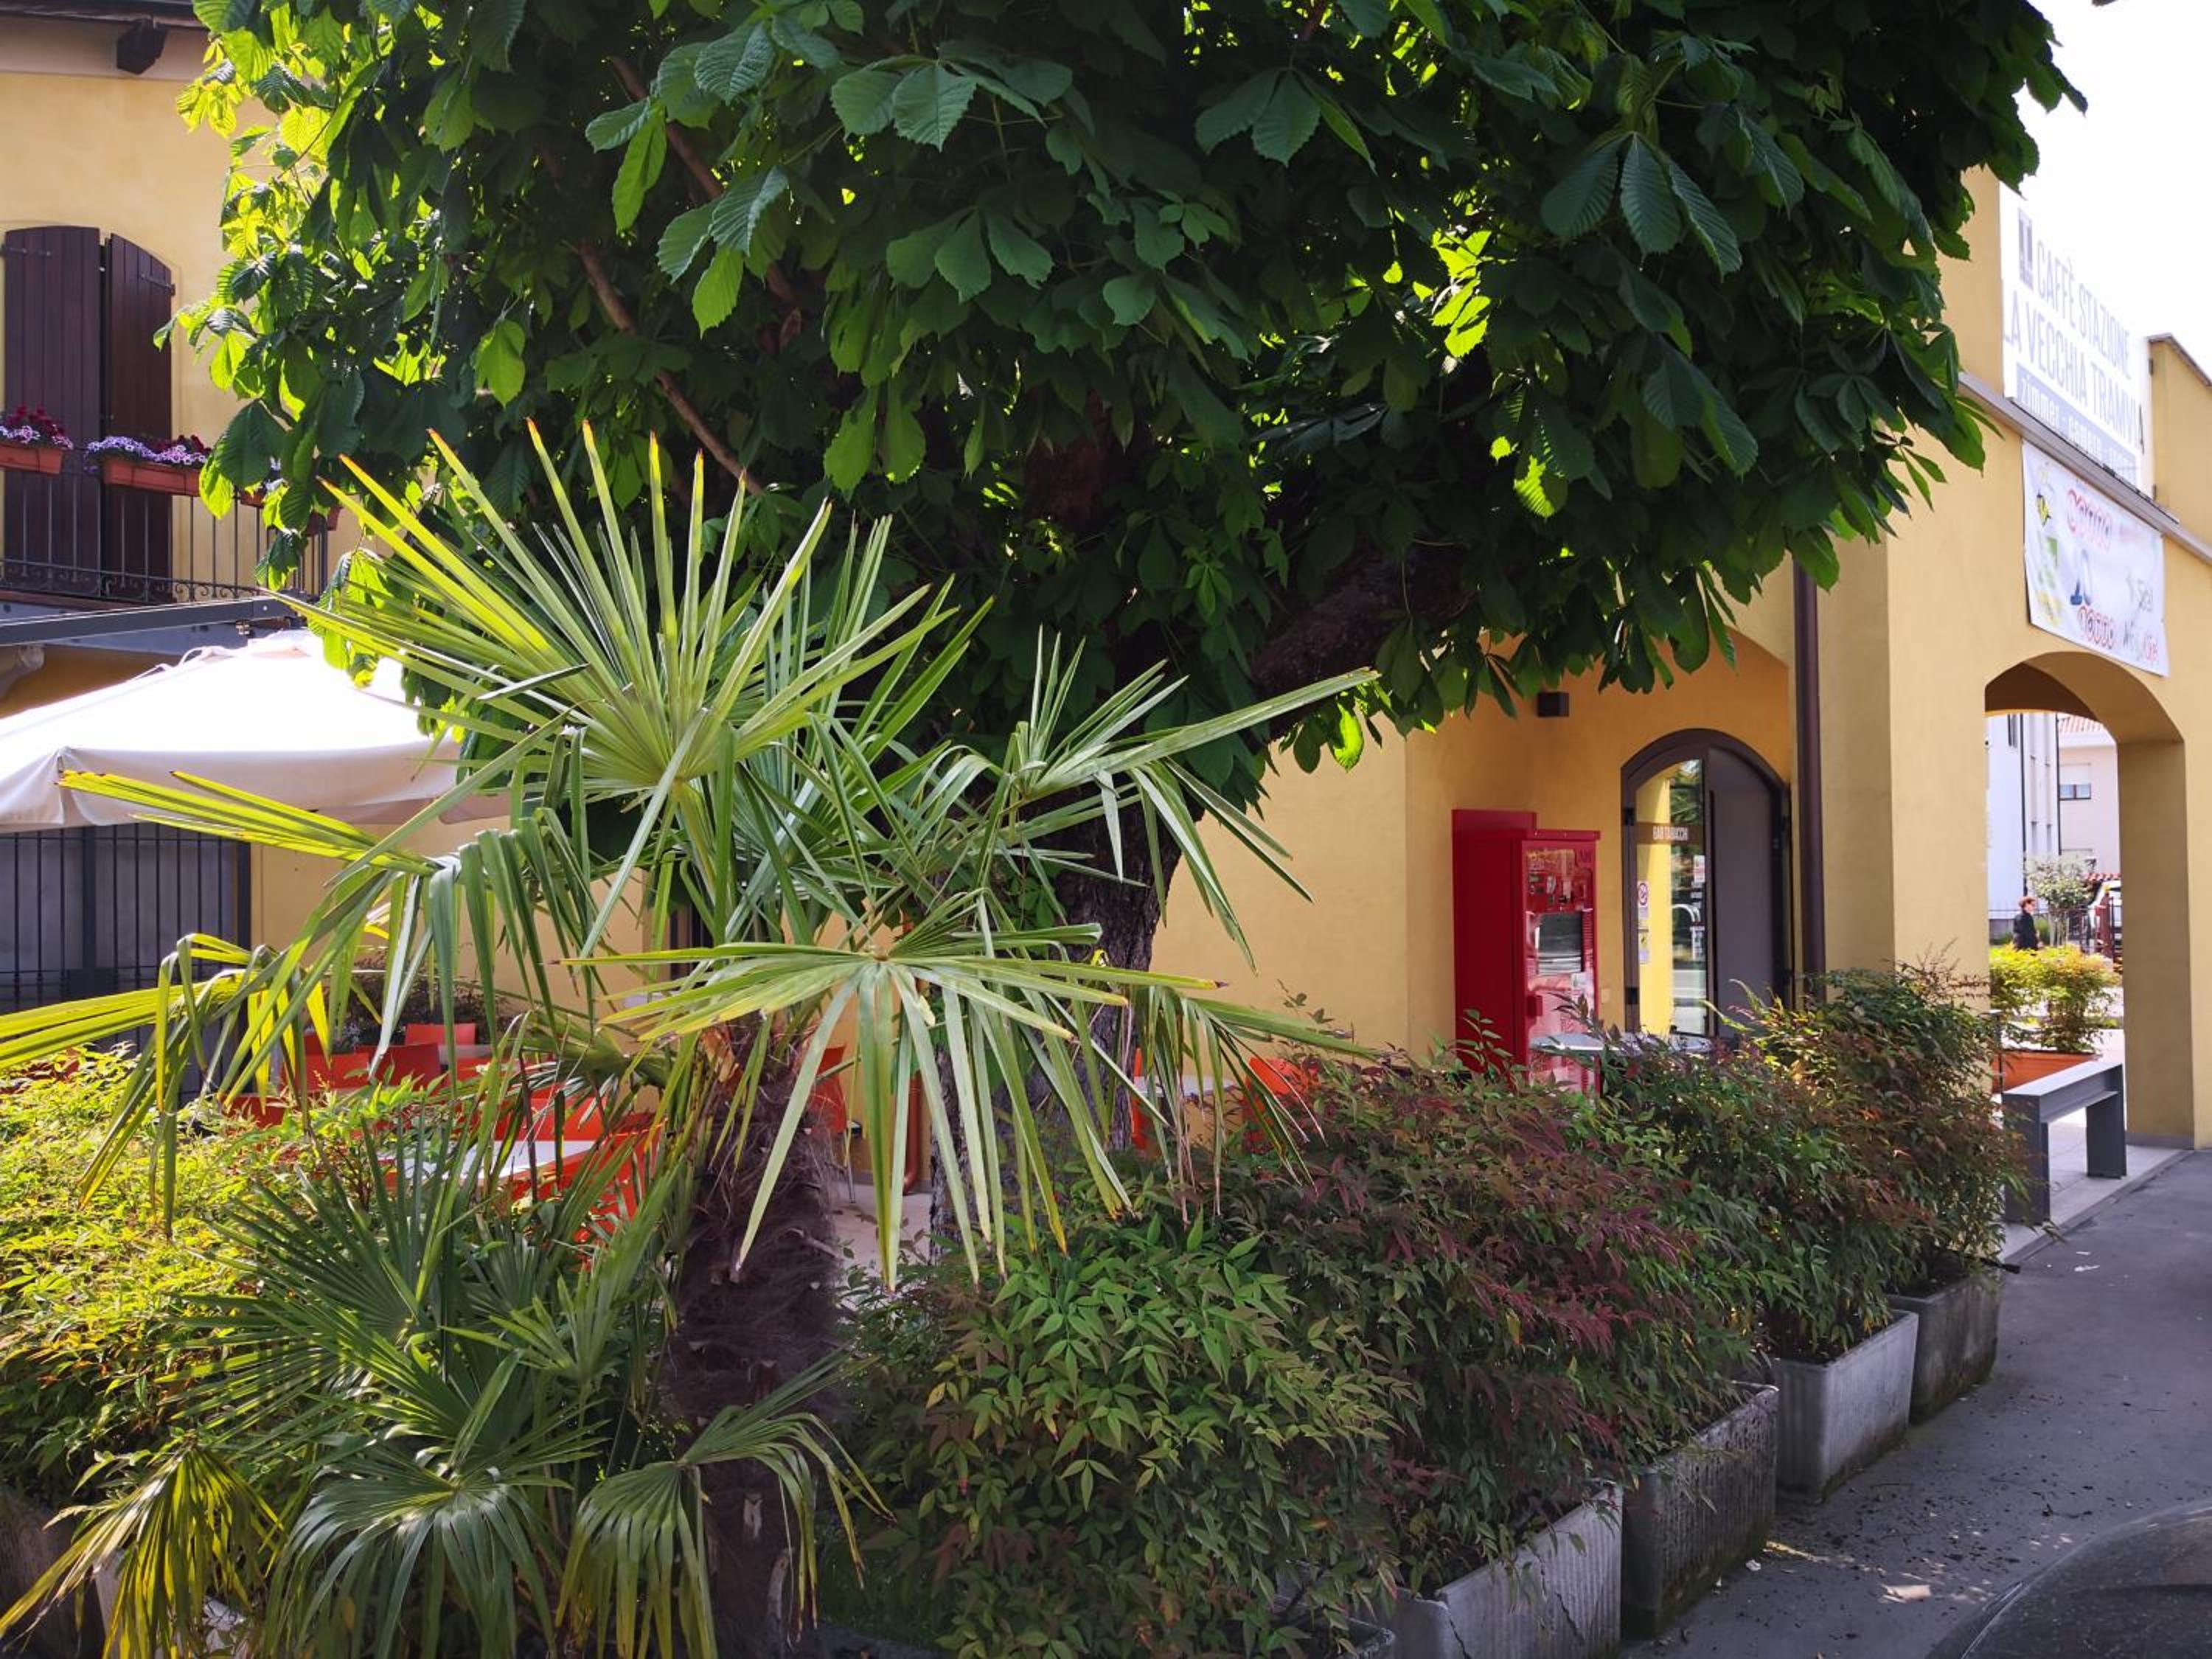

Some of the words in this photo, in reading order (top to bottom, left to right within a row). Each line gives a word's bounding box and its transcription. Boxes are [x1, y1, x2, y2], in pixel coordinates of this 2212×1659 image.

[2003, 290, 2022, 353] LA
[2025, 301, 2088, 408] VECCHIA
[2037, 239, 2076, 330] CAFFÈ
[2079, 283, 2132, 380] STAZIONE
